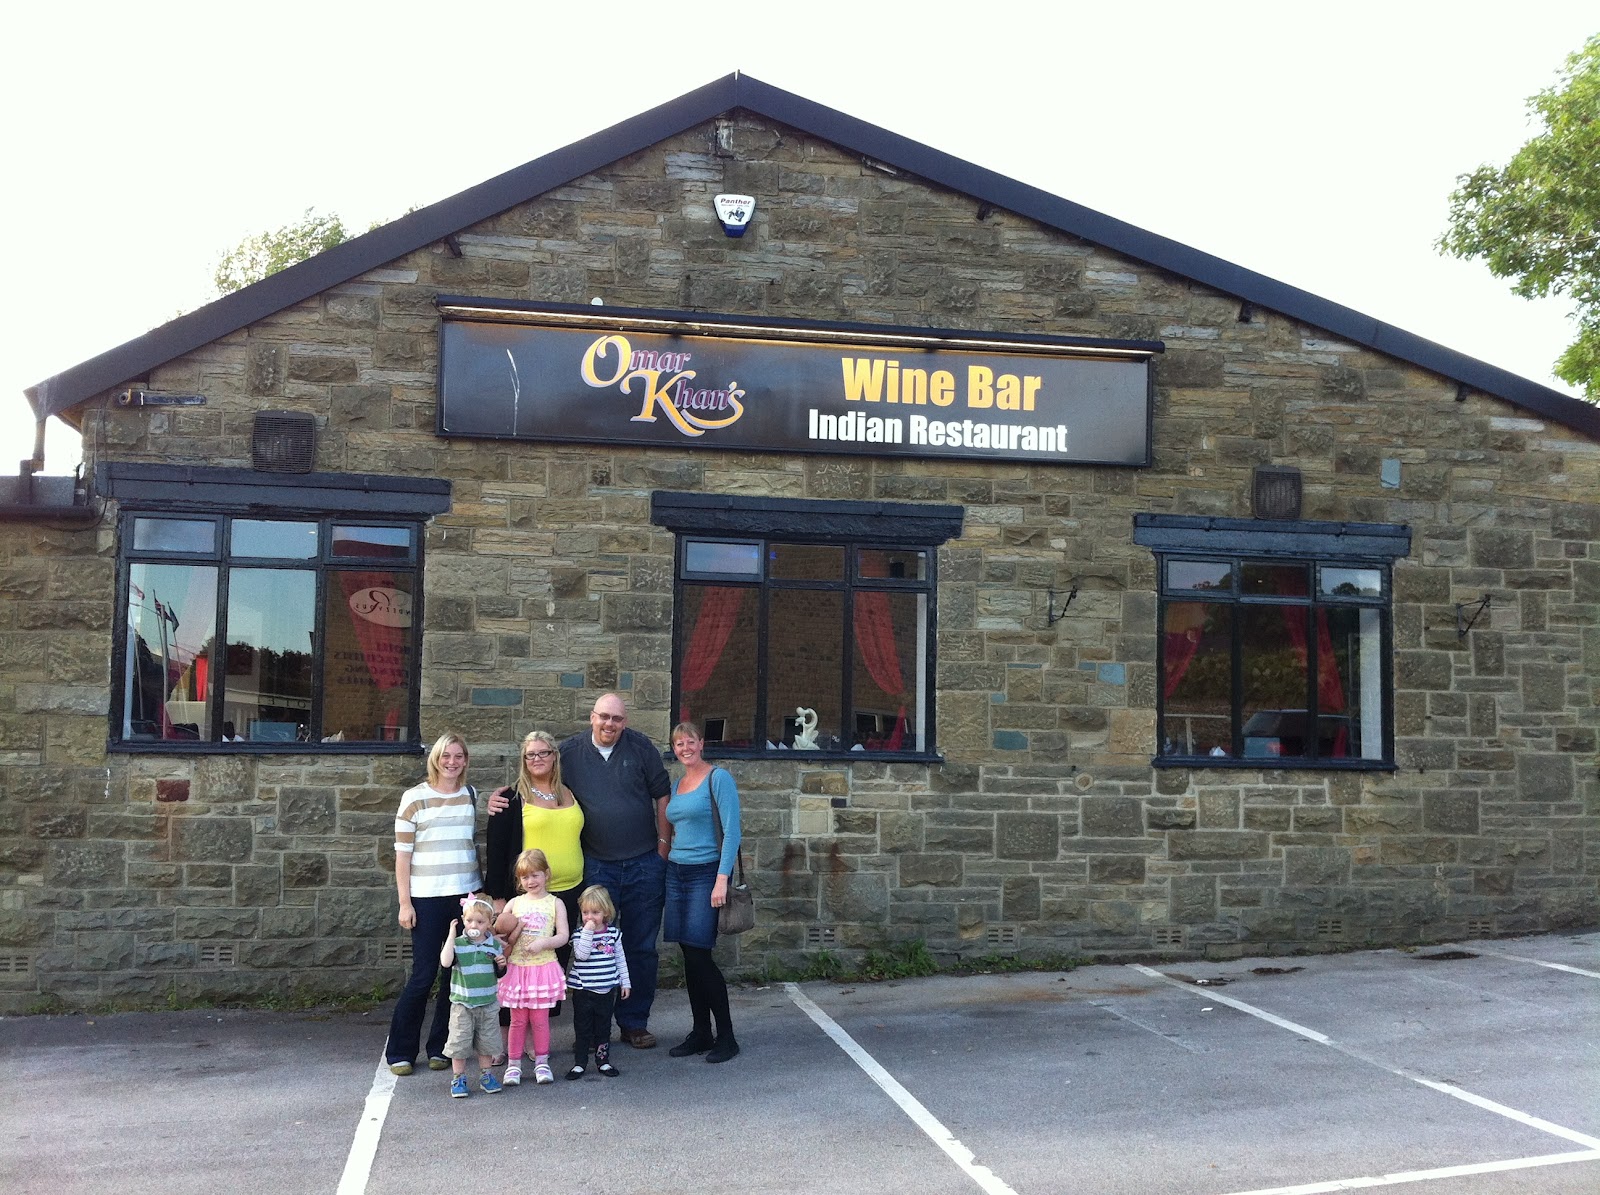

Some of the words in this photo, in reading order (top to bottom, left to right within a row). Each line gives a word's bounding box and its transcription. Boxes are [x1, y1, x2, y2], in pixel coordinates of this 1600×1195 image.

[581, 335, 692, 388] Omar
[841, 357, 955, 407] Wine
[967, 365, 1042, 411] Bar
[620, 370, 746, 437] Khan's
[808, 408, 903, 444] Indian
[909, 414, 1068, 453] Restaurant
